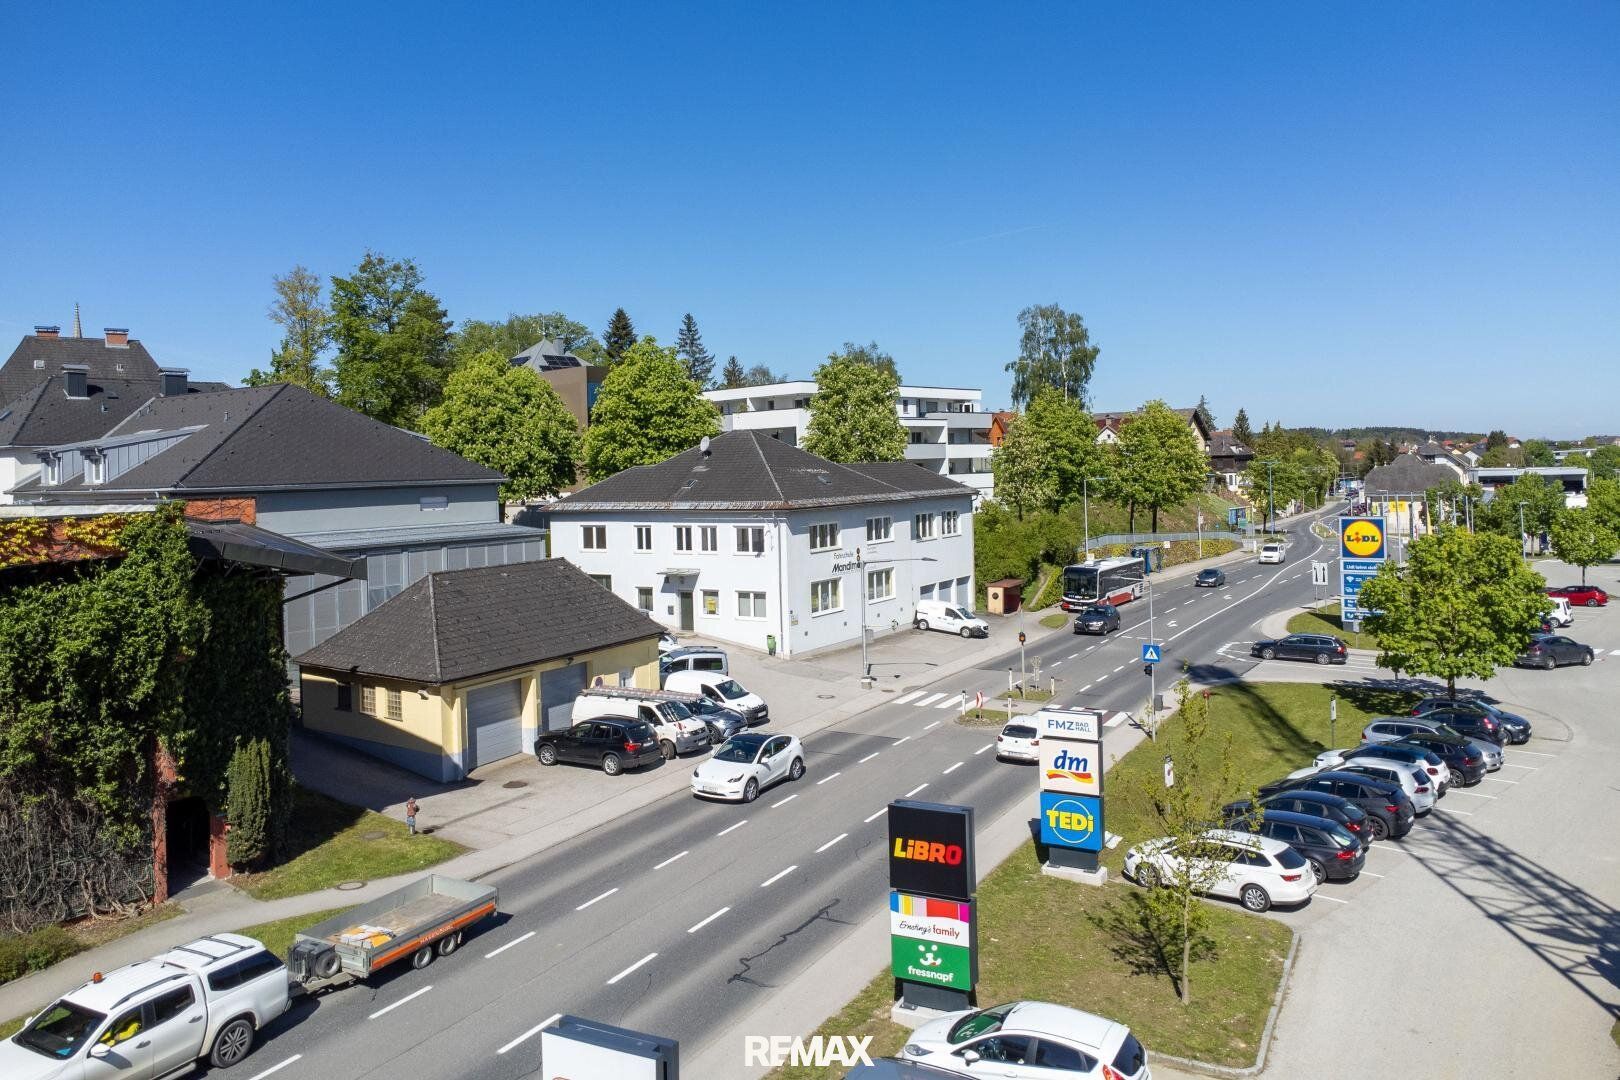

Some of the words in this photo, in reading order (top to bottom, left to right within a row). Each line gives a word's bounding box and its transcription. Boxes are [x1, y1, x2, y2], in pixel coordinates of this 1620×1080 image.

[1048, 719, 1075, 731] FMZ
[1054, 750, 1088, 772] dm
[899, 920, 932, 935] Ernsting's
[932, 924, 960, 940] family
[907, 965, 954, 983] fressnapf
